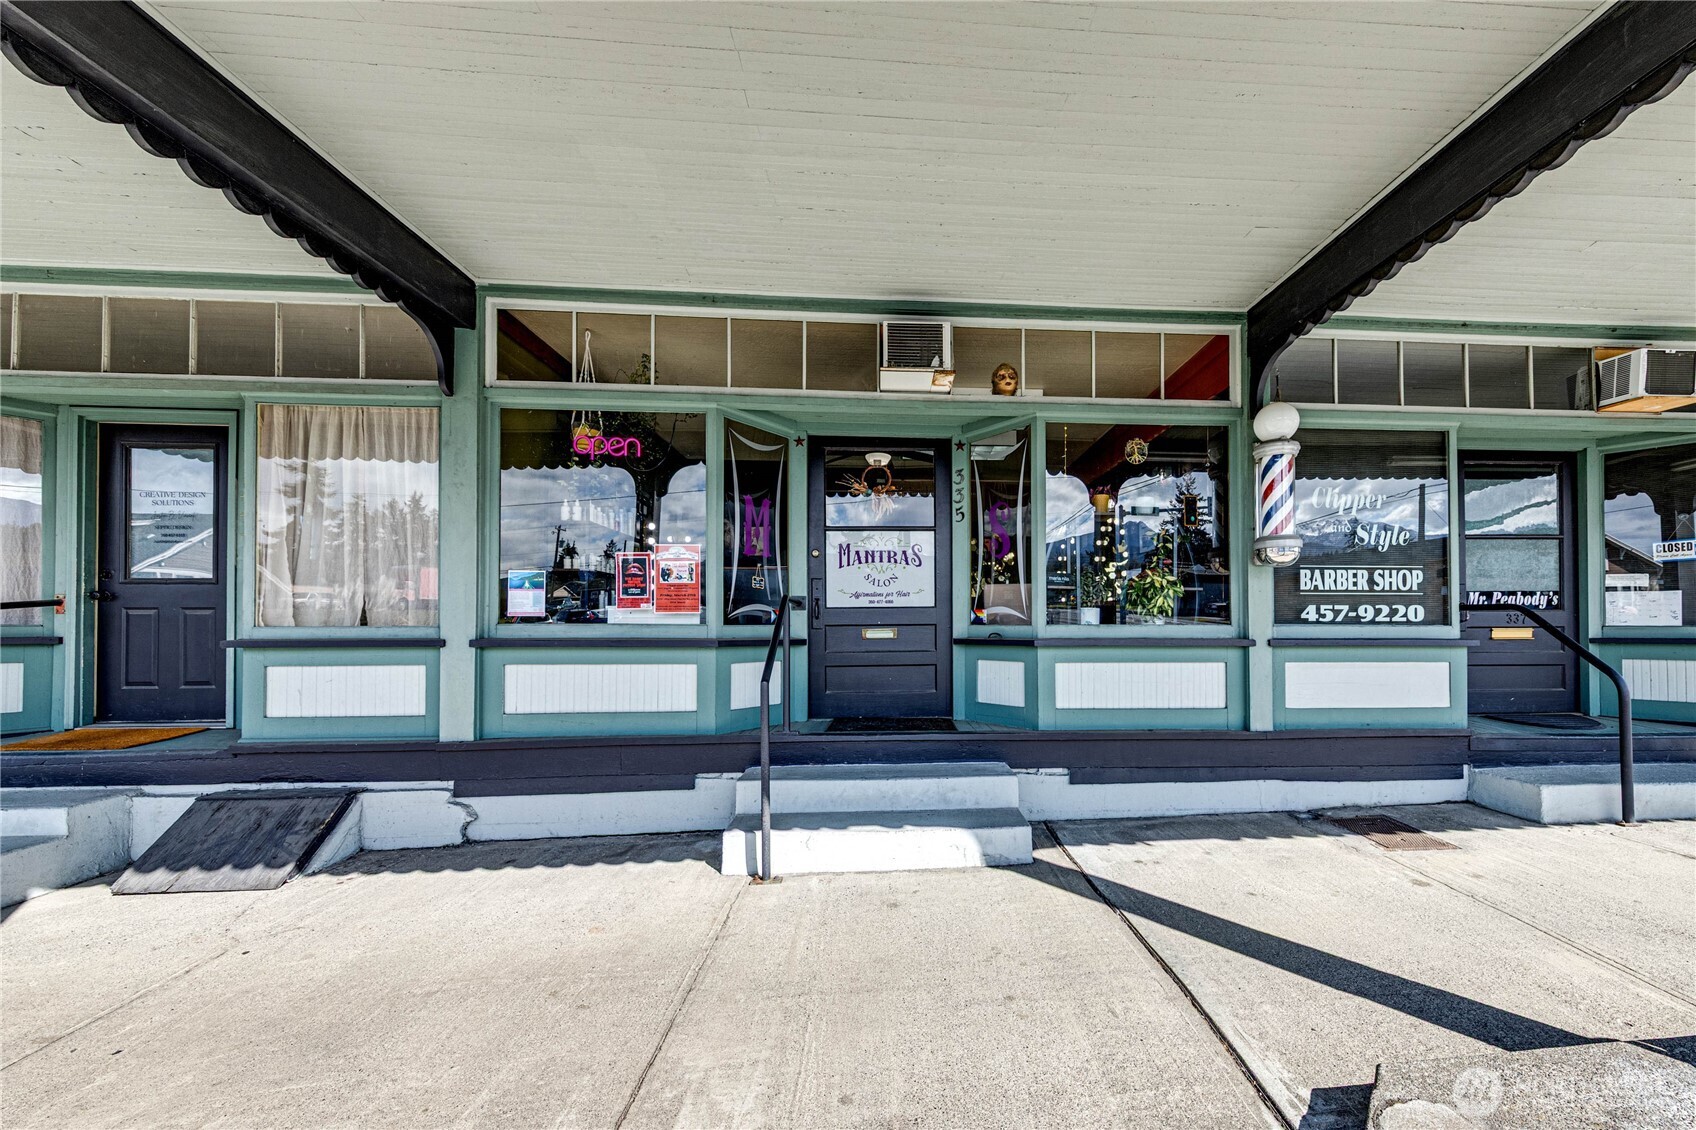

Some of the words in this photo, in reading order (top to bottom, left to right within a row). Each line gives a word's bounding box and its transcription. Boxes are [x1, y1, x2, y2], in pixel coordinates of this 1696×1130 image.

[573, 435, 641, 460] open
[953, 468, 965, 523] 335
[1311, 487, 1387, 515] Clipper
[743, 495, 772, 558] M
[988, 501, 1012, 559] S
[1331, 520, 1352, 532] and
[1354, 522, 1411, 552] Style
[838, 543, 923, 569] MANTRAS
[1656, 541, 1693, 553] CLOSED
[863, 573, 899, 588] SALON
[1300, 569, 1369, 591] BARBER
[1373, 569, 1424, 591] SHOP
[849, 590, 884, 600] Affirmations
[884, 591, 894, 599] for
[895, 590, 911, 598] Hair
[1467, 591, 1488, 605] Mr.
[1492, 591, 1559, 609] Peabody's
[1301, 604, 1425, 622] 457-9220
